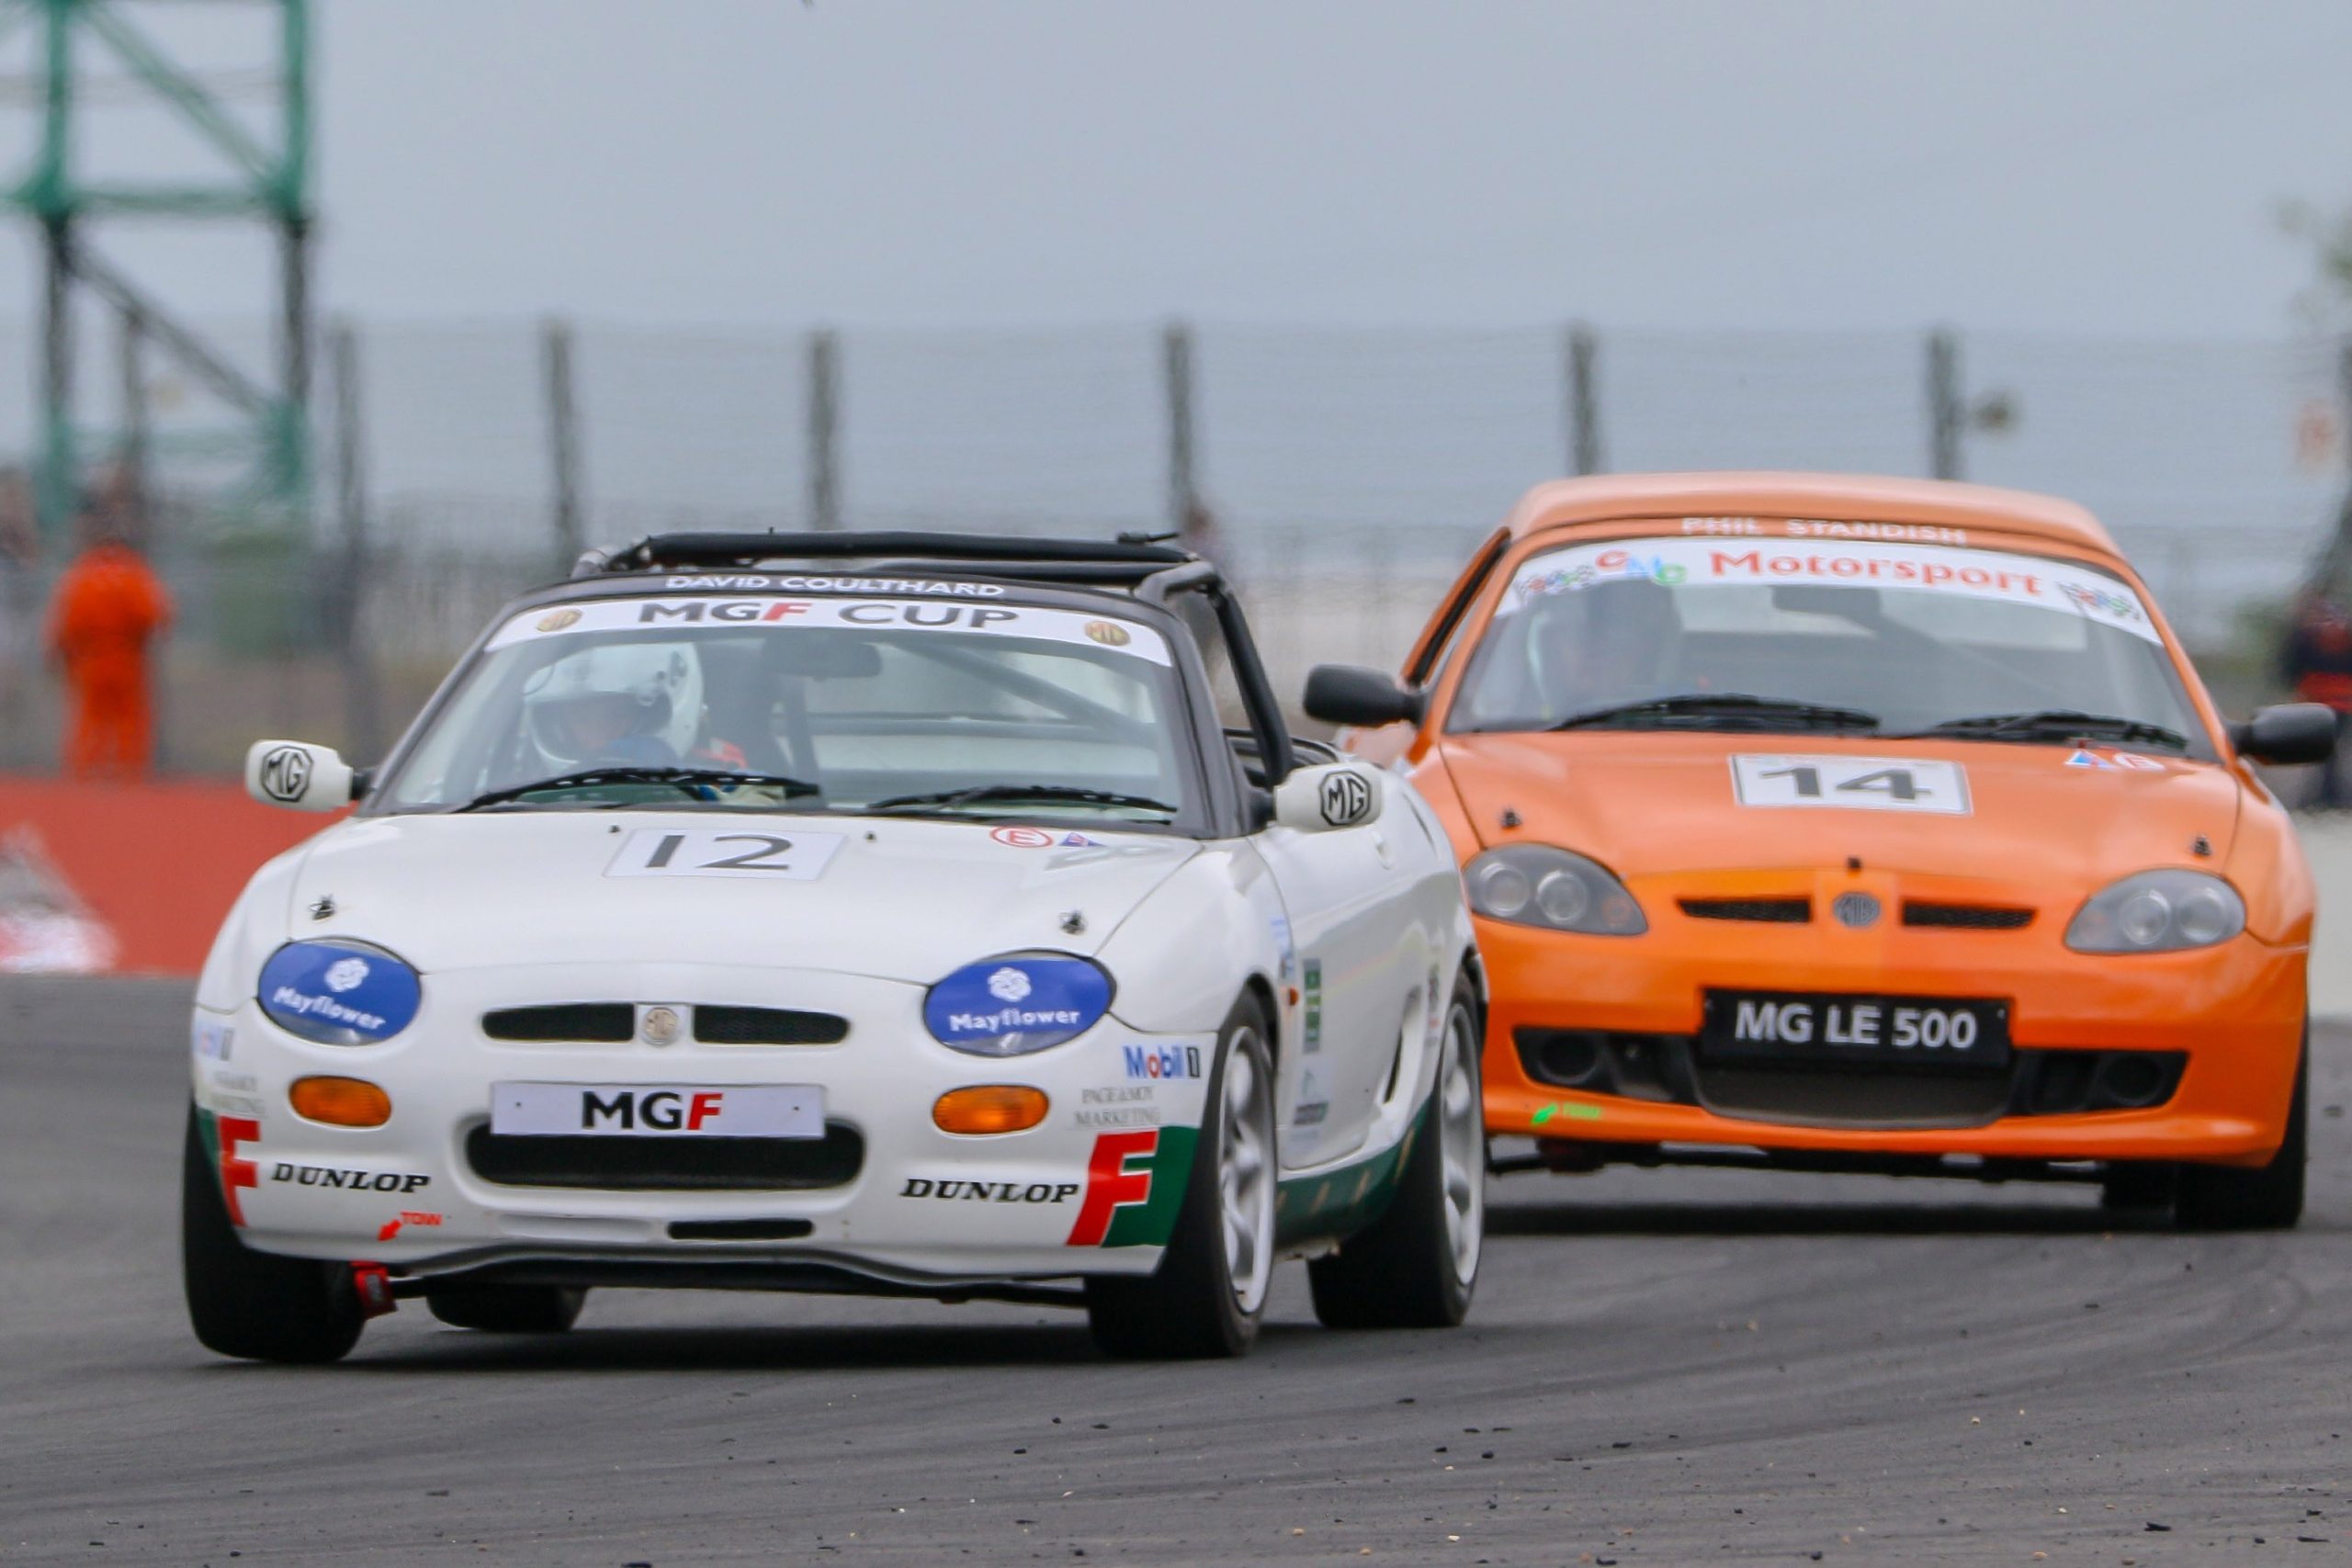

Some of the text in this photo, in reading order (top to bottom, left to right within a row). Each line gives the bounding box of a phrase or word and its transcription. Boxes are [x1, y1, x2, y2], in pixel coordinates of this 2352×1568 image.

[1682, 517, 1968, 545] PHIL STANDISH
[665, 575, 1005, 596] DAVID COULTHARD
[1710, 550, 2041, 595] Motorsport
[639, 602, 1020, 628] MGF CUP
[264, 749, 306, 796] MG
[1760, 767, 1932, 799] 14
[1326, 775, 1366, 821] MG
[645, 834, 792, 870] 12
[1007, 829, 1037, 845] E
[273, 986, 386, 1030] Mayflower
[949, 1009, 1080, 1032] Mayflower
[1735, 999, 1976, 1048] MG LE 500
[1122, 1044, 1183, 1078] Mobil
[581, 1090, 723, 1131] MGF
[1073, 1107, 1160, 1126] MARKETING
[272, 1162, 432, 1193] DUNLOP
[899, 1178, 1080, 1204] DUNLOP
[1064, 1129, 1159, 1247] F
[401, 1211, 442, 1226] TOW
